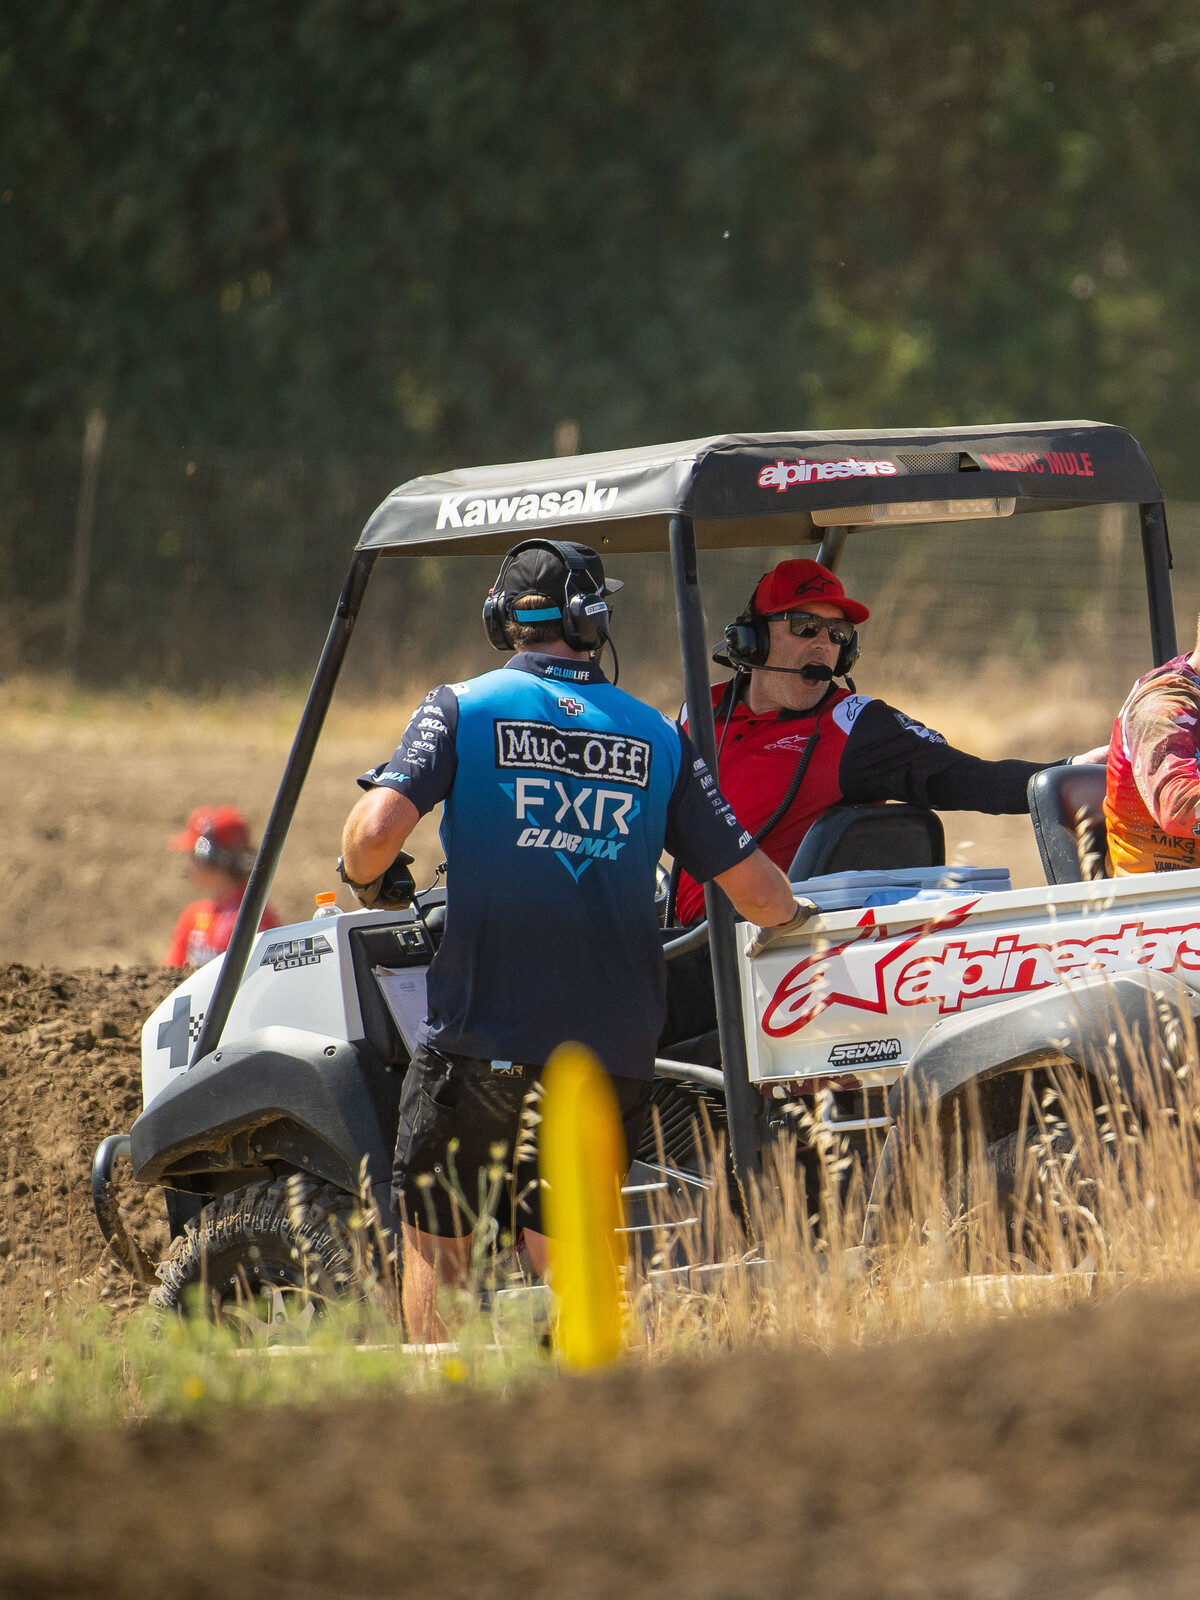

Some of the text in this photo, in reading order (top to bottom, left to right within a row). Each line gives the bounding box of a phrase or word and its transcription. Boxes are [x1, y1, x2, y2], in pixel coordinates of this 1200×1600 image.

[757, 457, 899, 493] alpinestars
[980, 452, 1094, 476] MEDIC MULE
[435, 480, 619, 530] Kawasaki
[545, 665, 590, 681] #CLUBLIFE
[505, 729, 643, 779] Muc-Off
[515, 777, 634, 835] FXR
[516, 828, 627, 861] CLUBMX
[260, 935, 334, 966] MULE
[275, 955, 321, 971] 4010
[829, 1039, 901, 1061] SEDONA
